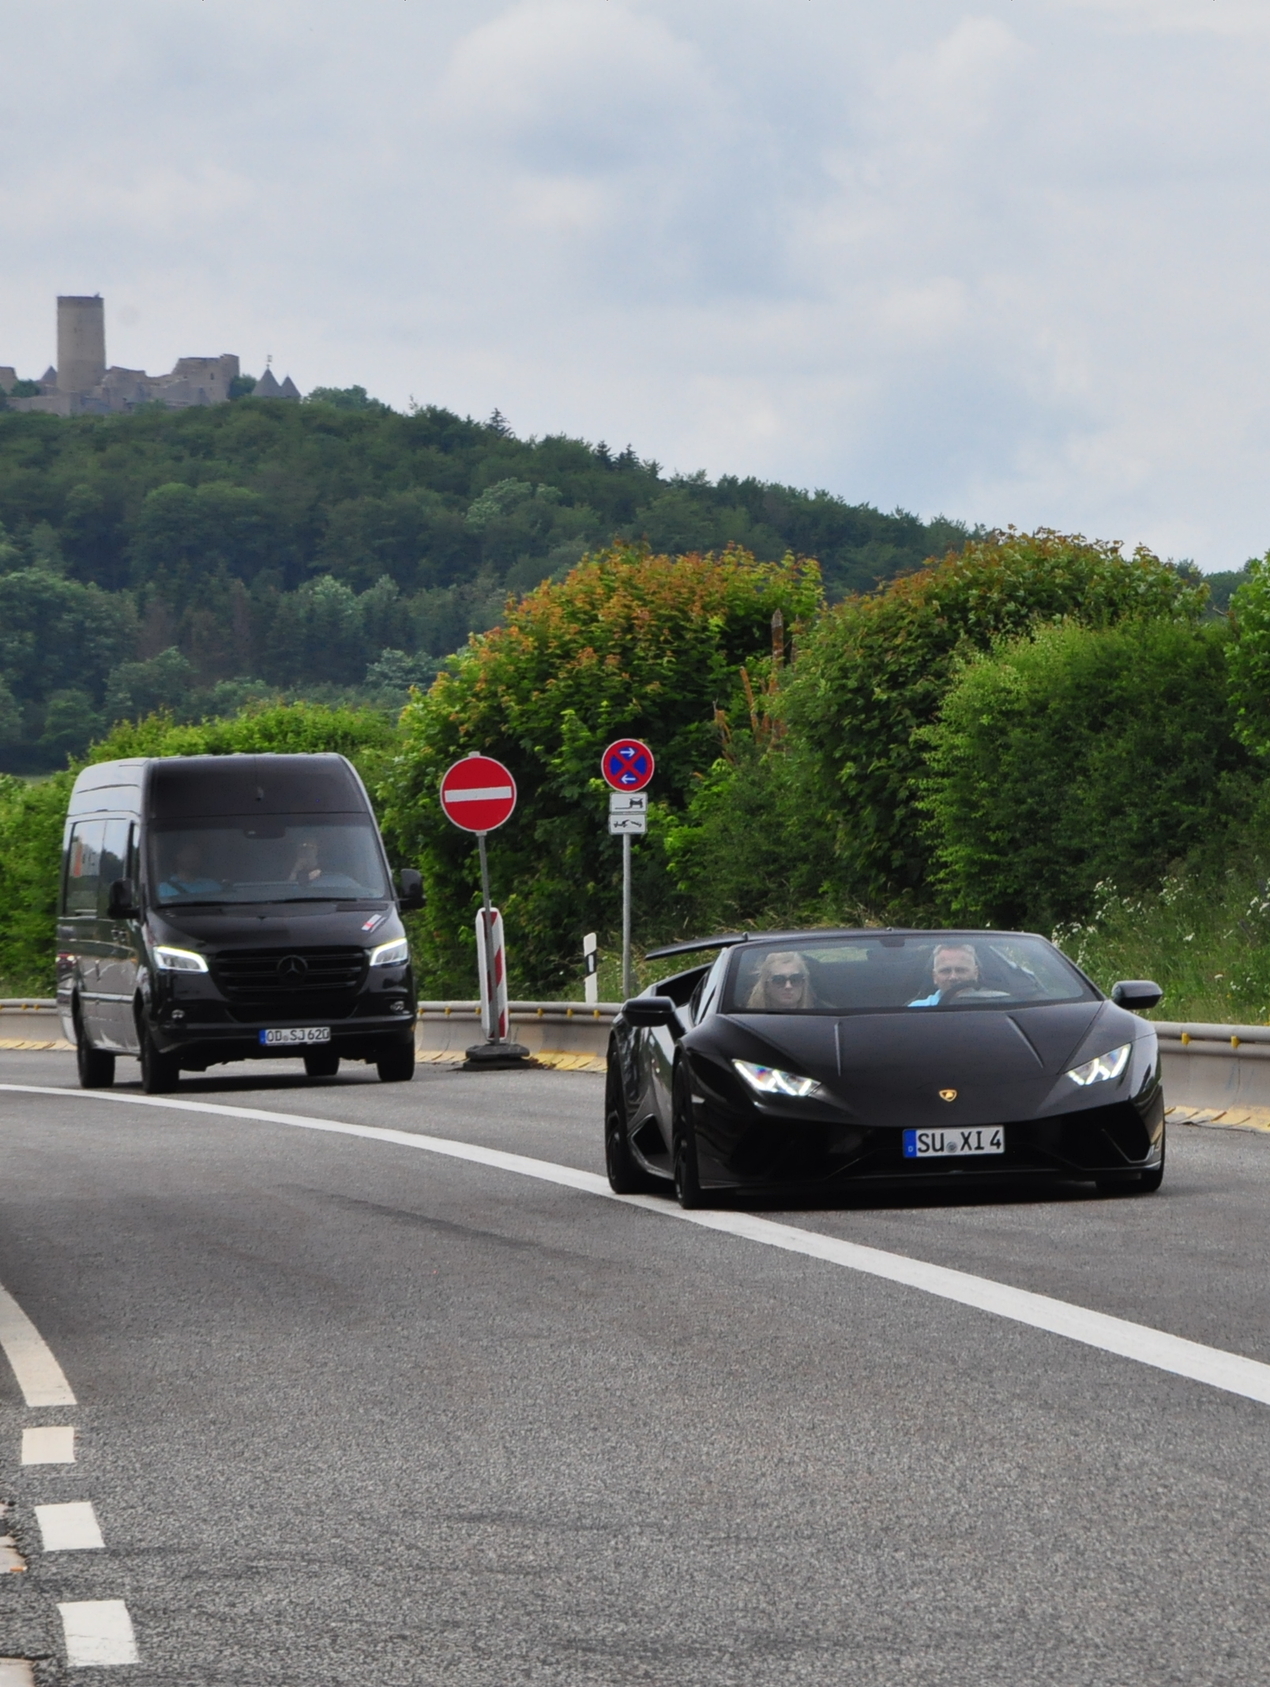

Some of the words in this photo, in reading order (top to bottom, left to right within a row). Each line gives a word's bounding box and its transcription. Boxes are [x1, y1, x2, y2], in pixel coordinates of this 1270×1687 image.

[267, 1030, 282, 1042] OD
[290, 1029, 305, 1041] SJ
[917, 1132, 944, 1153] SU
[960, 1131, 985, 1151] XI
[990, 1129, 1002, 1149] 4
